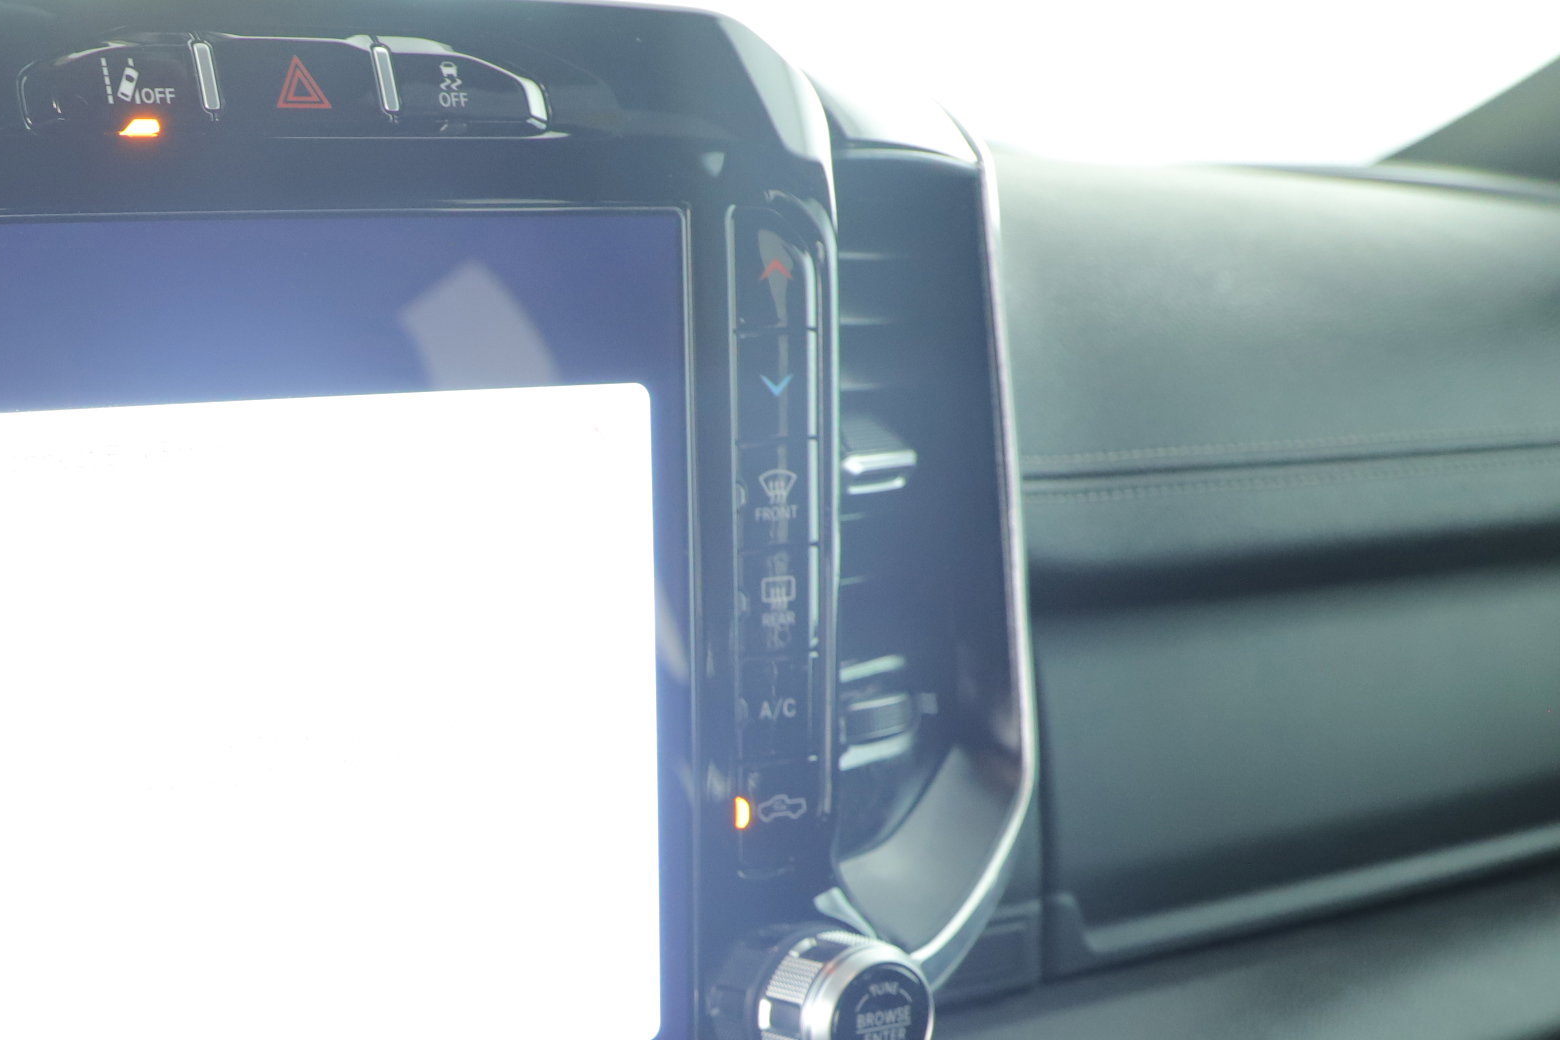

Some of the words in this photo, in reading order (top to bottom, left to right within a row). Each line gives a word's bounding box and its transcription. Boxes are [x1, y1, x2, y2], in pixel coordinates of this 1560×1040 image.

[141, 86, 176, 105] OFF
[439, 91, 469, 108] OFF
[755, 504, 798, 521] FRONT
[760, 698, 797, 719] A/C
[869, 981, 900, 997] TUNE
[856, 1005, 911, 1028] BROWSE
